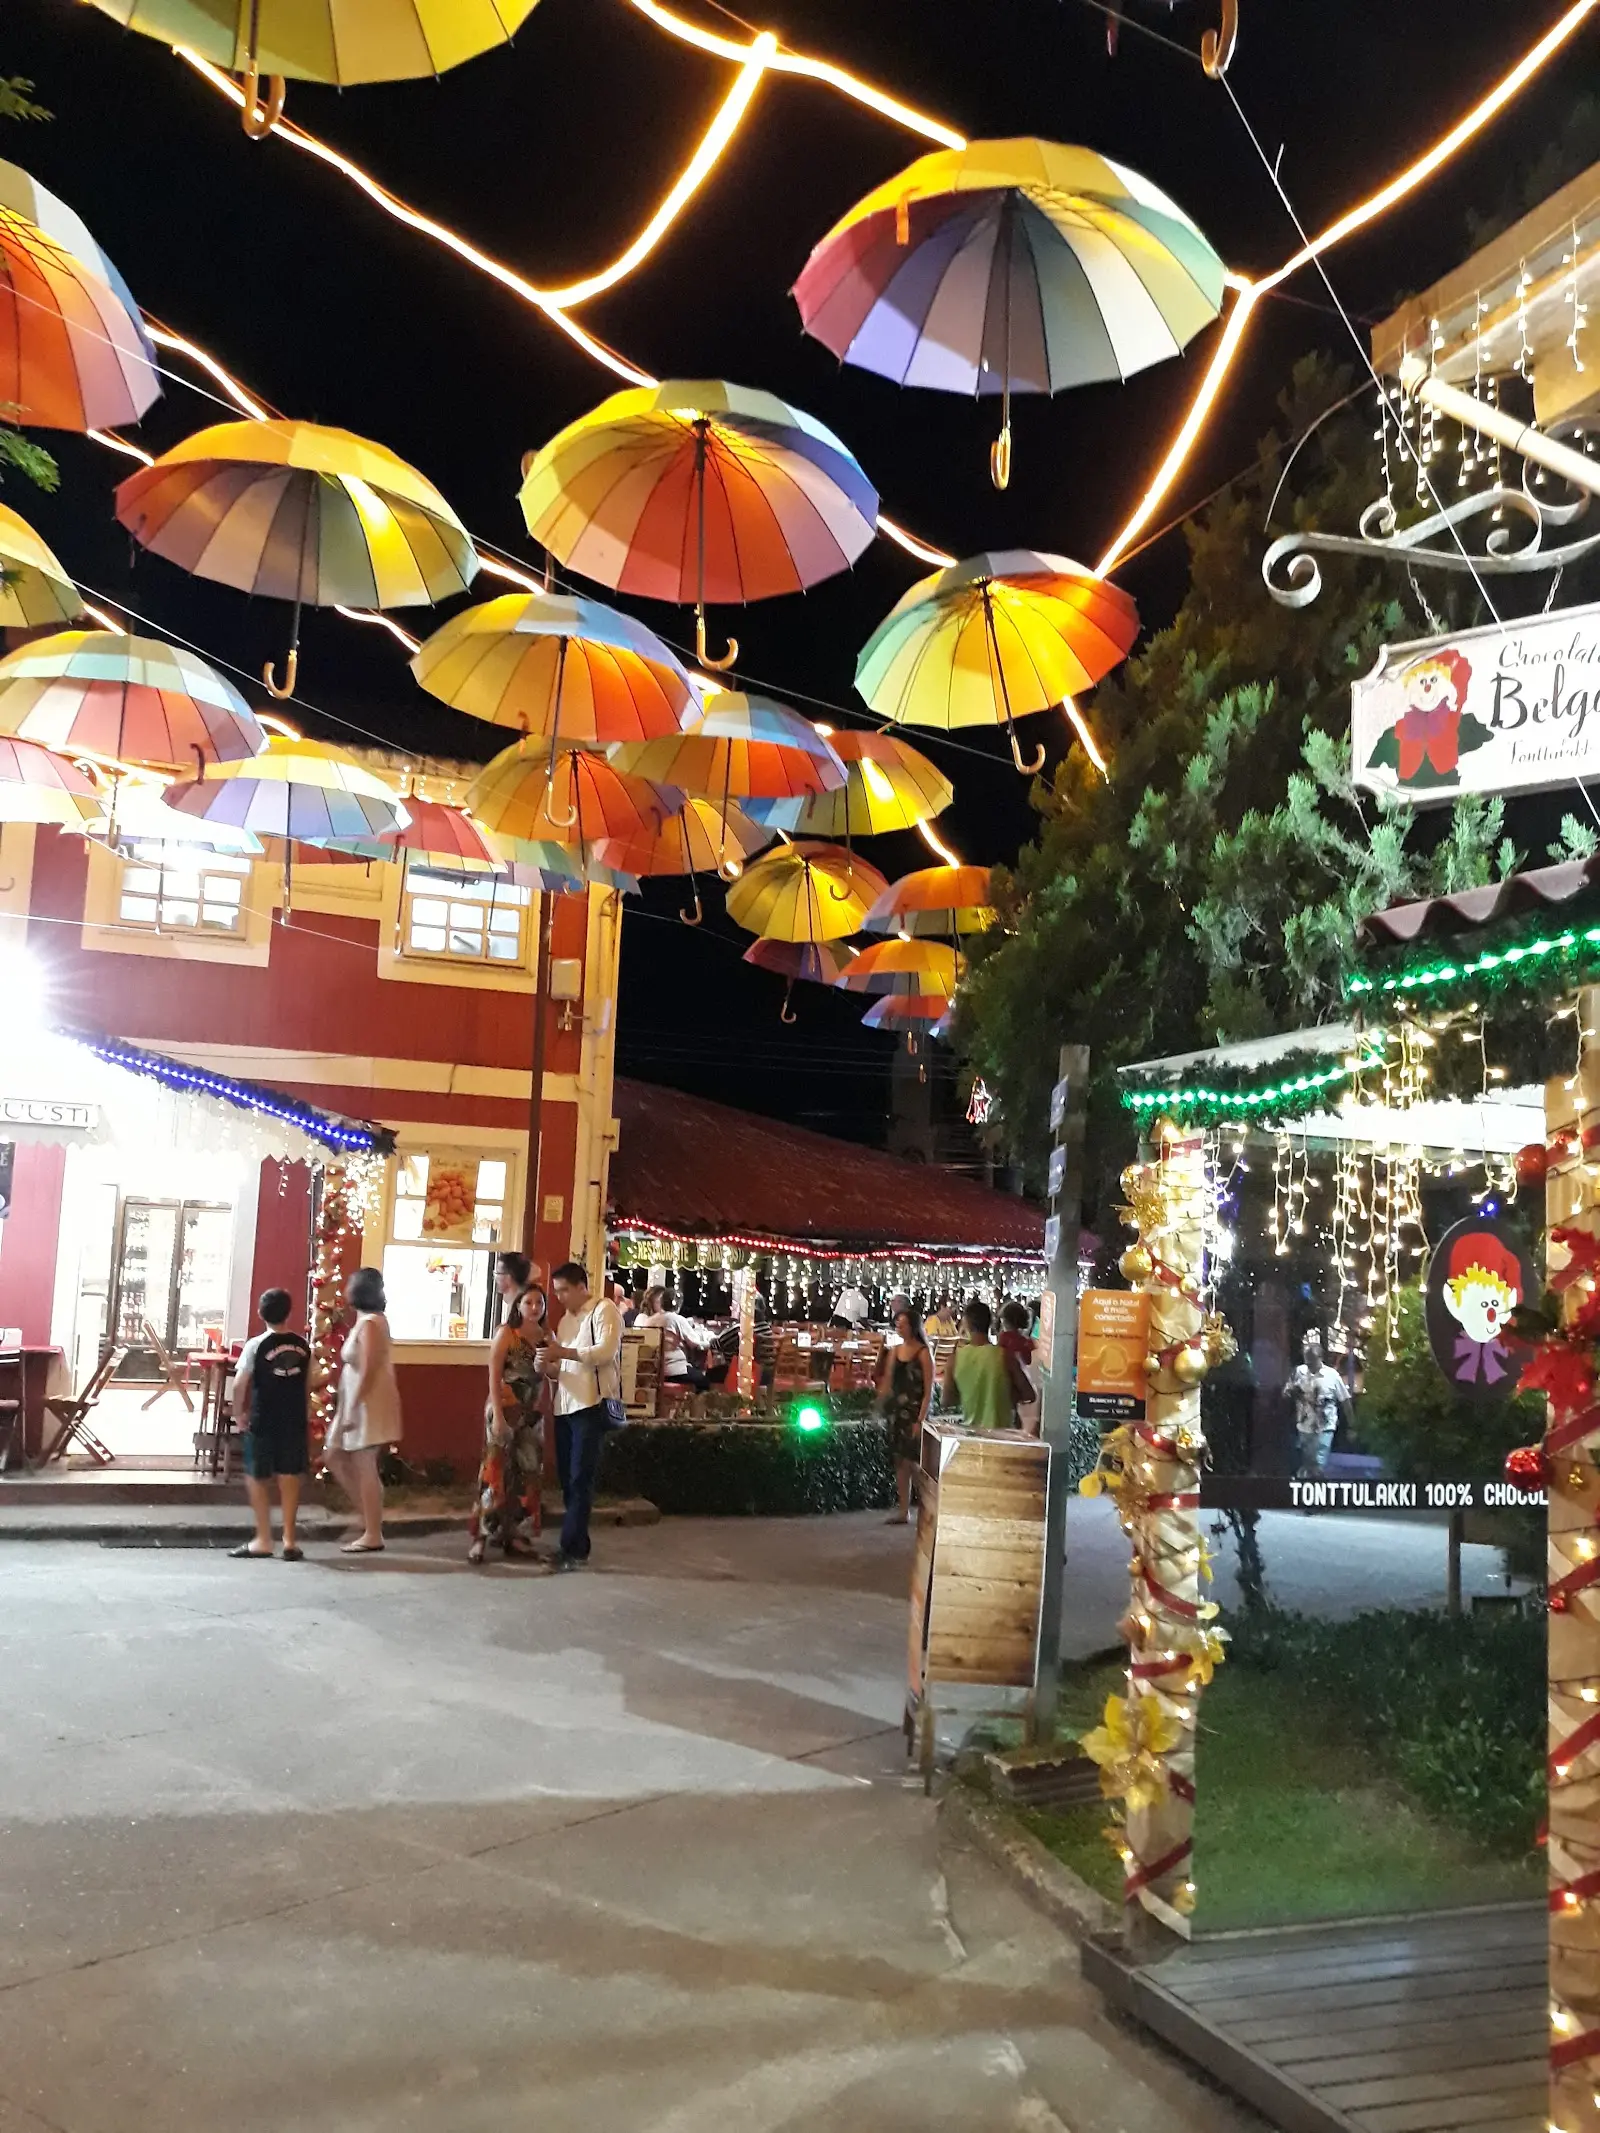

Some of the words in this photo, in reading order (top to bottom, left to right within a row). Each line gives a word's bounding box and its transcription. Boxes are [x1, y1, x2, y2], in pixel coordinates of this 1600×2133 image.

[1498, 631, 1600, 668] Chocolat
[1288, 1481, 1417, 1507] TONTTULAKKI
[1425, 1483, 1474, 1507] 100%
